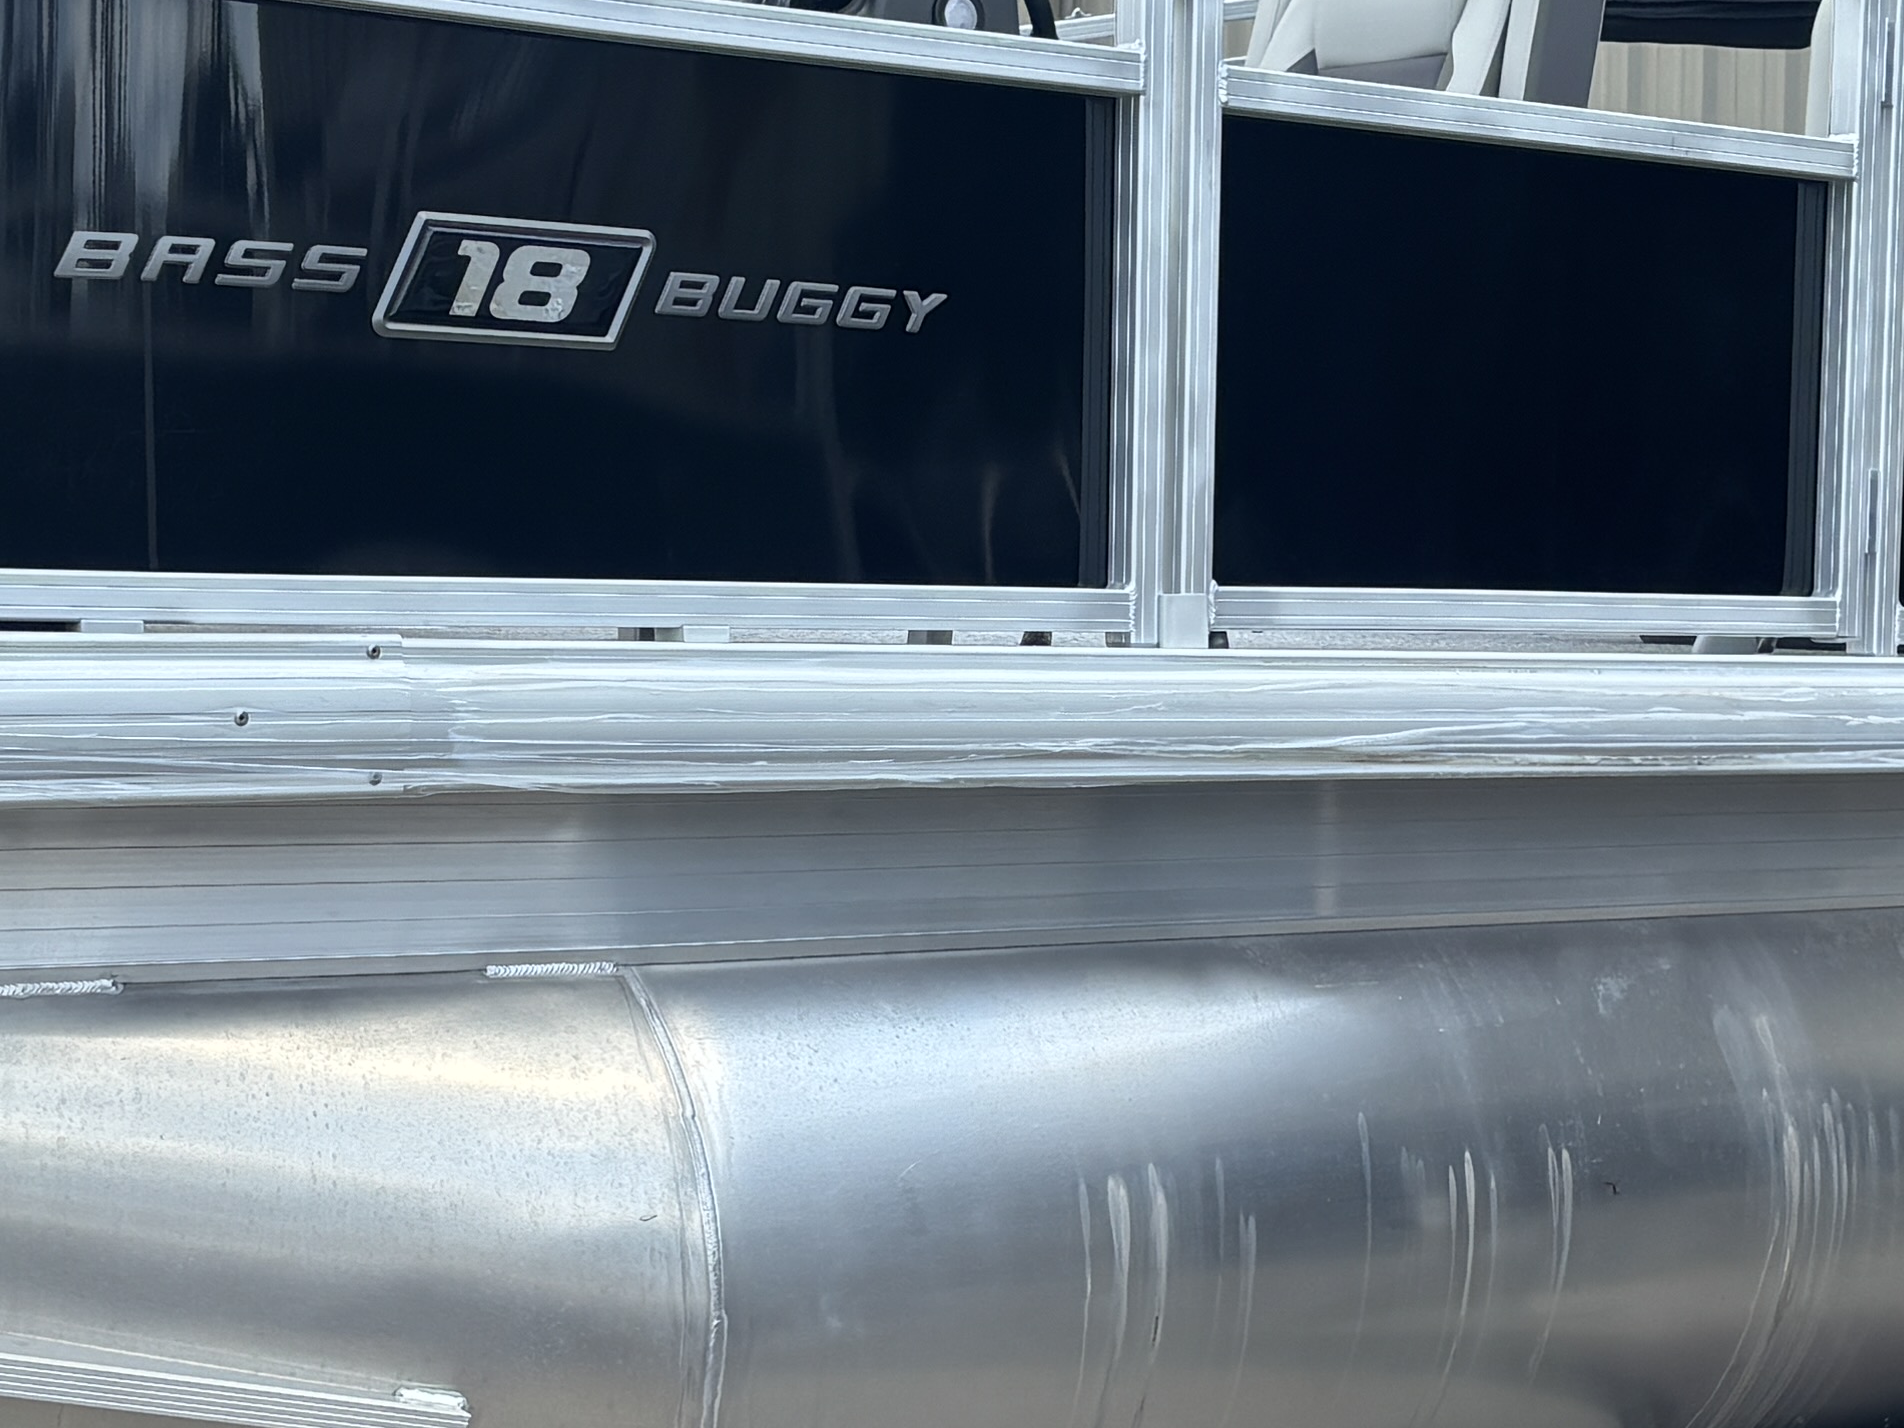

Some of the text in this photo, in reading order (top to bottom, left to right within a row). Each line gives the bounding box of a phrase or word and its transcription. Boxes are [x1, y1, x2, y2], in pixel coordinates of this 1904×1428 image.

[53, 229, 948, 335] BASS 18 BUGGY
